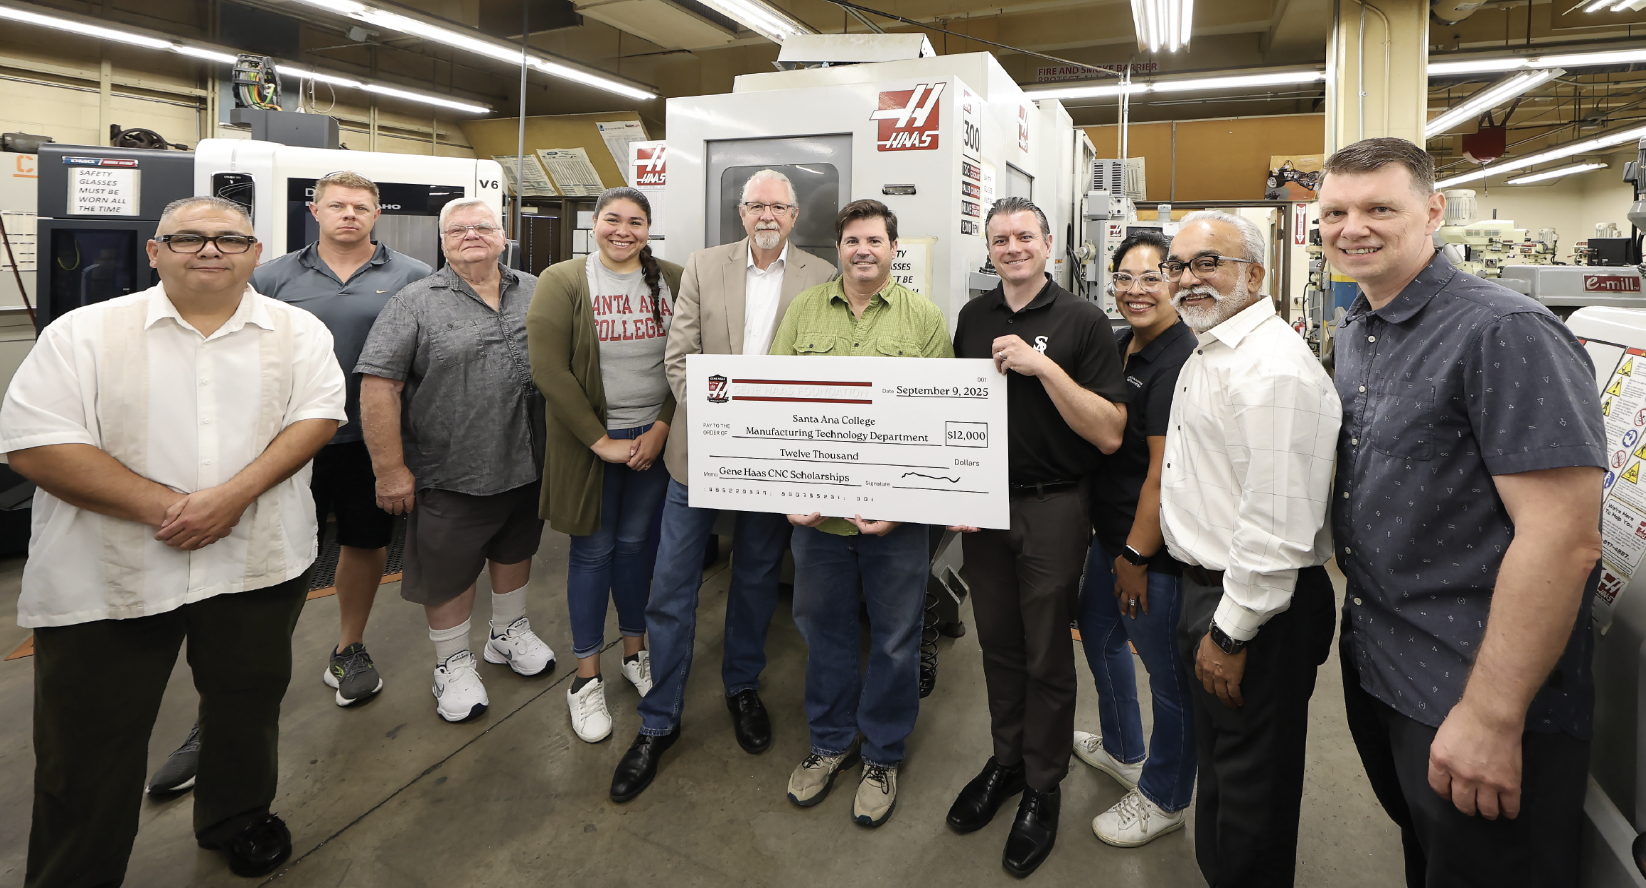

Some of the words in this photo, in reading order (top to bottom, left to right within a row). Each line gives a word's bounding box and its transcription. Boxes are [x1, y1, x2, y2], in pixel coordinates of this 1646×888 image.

[1038, 67, 1057, 76] FIRE
[1059, 66, 1079, 74] AND
[879, 130, 938, 148] HAAS
[964, 119, 980, 153] 300
[79, 179, 117, 187] GLASSES
[638, 172, 666, 184] HAAS
[79, 196, 109, 204] WORN
[902, 275, 914, 284] BE
[1586, 276, 1634, 290] e-mill
[592, 294, 633, 316] ANTA
[733, 384, 761, 395] GENE
[764, 385, 794, 396] HAAS
[797, 386, 869, 398] FOUNDATION
[896, 385, 950, 397] September
[952, 386, 962, 397] 9,
[963, 387, 989, 397] 2025
[792, 414, 819, 424] Santa
[820, 415, 840, 425] Ana
[841, 415, 876, 427] College
[745, 426, 814, 440] Manufacturing
[815, 429, 869, 442] Technology
[870, 431, 929, 443] Department
[947, 430, 987, 442] $12,000
[779, 448, 811, 458] Twelve
[812, 449, 859, 460] Thousand
[954, 458, 980, 467] Dollars
[719, 466, 743, 476] Gene
[743, 467, 767, 477] Haas
[768, 468, 789, 478] CNC
[790, 470, 850, 483] Scholarships
